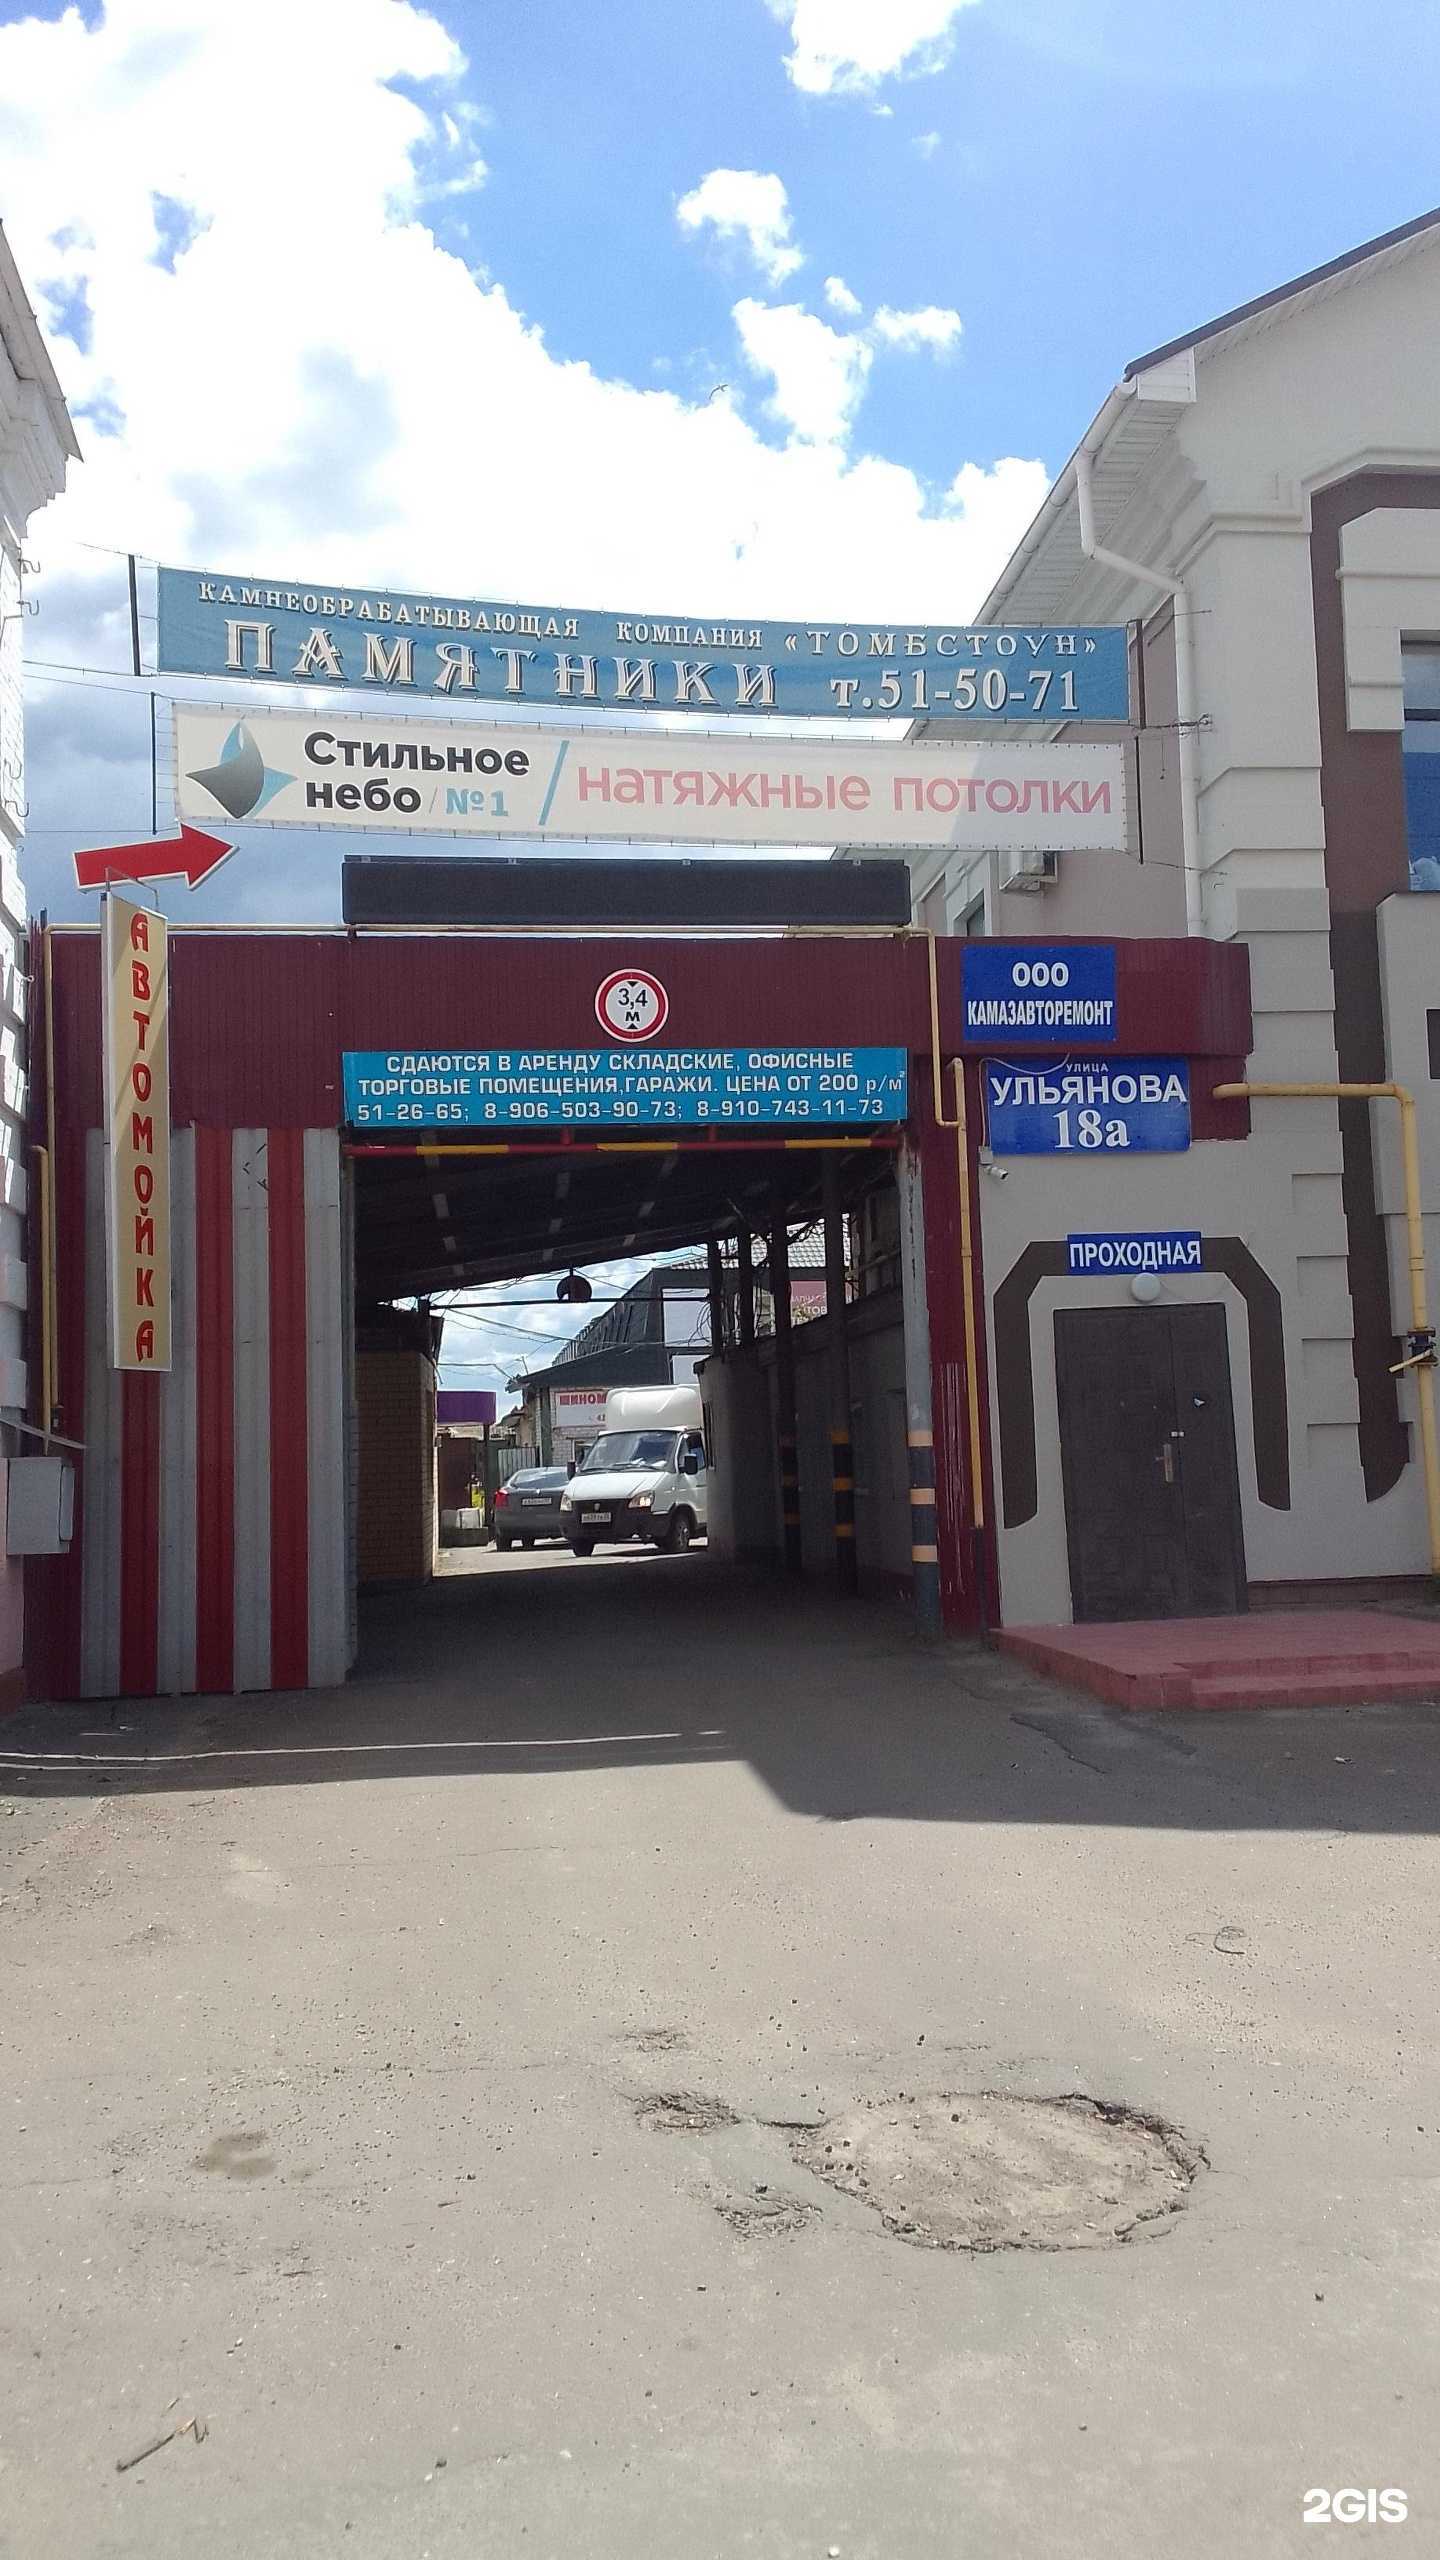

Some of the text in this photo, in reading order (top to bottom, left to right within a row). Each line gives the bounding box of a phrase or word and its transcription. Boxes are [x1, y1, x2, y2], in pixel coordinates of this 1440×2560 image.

[199, 581, 1096, 657] КАМНЕОБРАБАТЫВАЮЩАЯ КОМПАНИЯ «ТОМБСТОУН»
[224, 618, 777, 708] ПАМЯТНИКИ
[304, 731, 530, 776] Стильное
[306, 778, 421, 813] небо
[579, 765, 1111, 815] натяжные потолки
[1012, 962, 1069, 987] ООО
[618, 987, 648, 1010] 3,4
[967, 1000, 1113, 1026] КАМАЗАВТОРЕМОНТ
[387, 1052, 853, 1075] СДАЮТСЯ В АРЕНДУ СКЛАДСКИЕ, ОФИСНЫЕ
[1066, 1063, 1109, 1074] УЛИЦА
[358, 1078, 471, 1096] ТОРГОВЫЕ
[726, 1075, 780, 1096] ЦЕНА
[787, 1075, 812, 1092] ОТ
[819, 1074, 858, 1091] 200
[990, 1074, 1188, 1106] УЛЬЯНОВА
[357, 1098, 884, 1122] 51-26-65; 8-906-503-90-73; 8-910-743-11-73
[130, 912, 156, 1362] АВТОМОЙКА
[1053, 1109, 1131, 1149] 18а
[1069, 1240, 1202, 1270] ПРОХОДНАЯ
